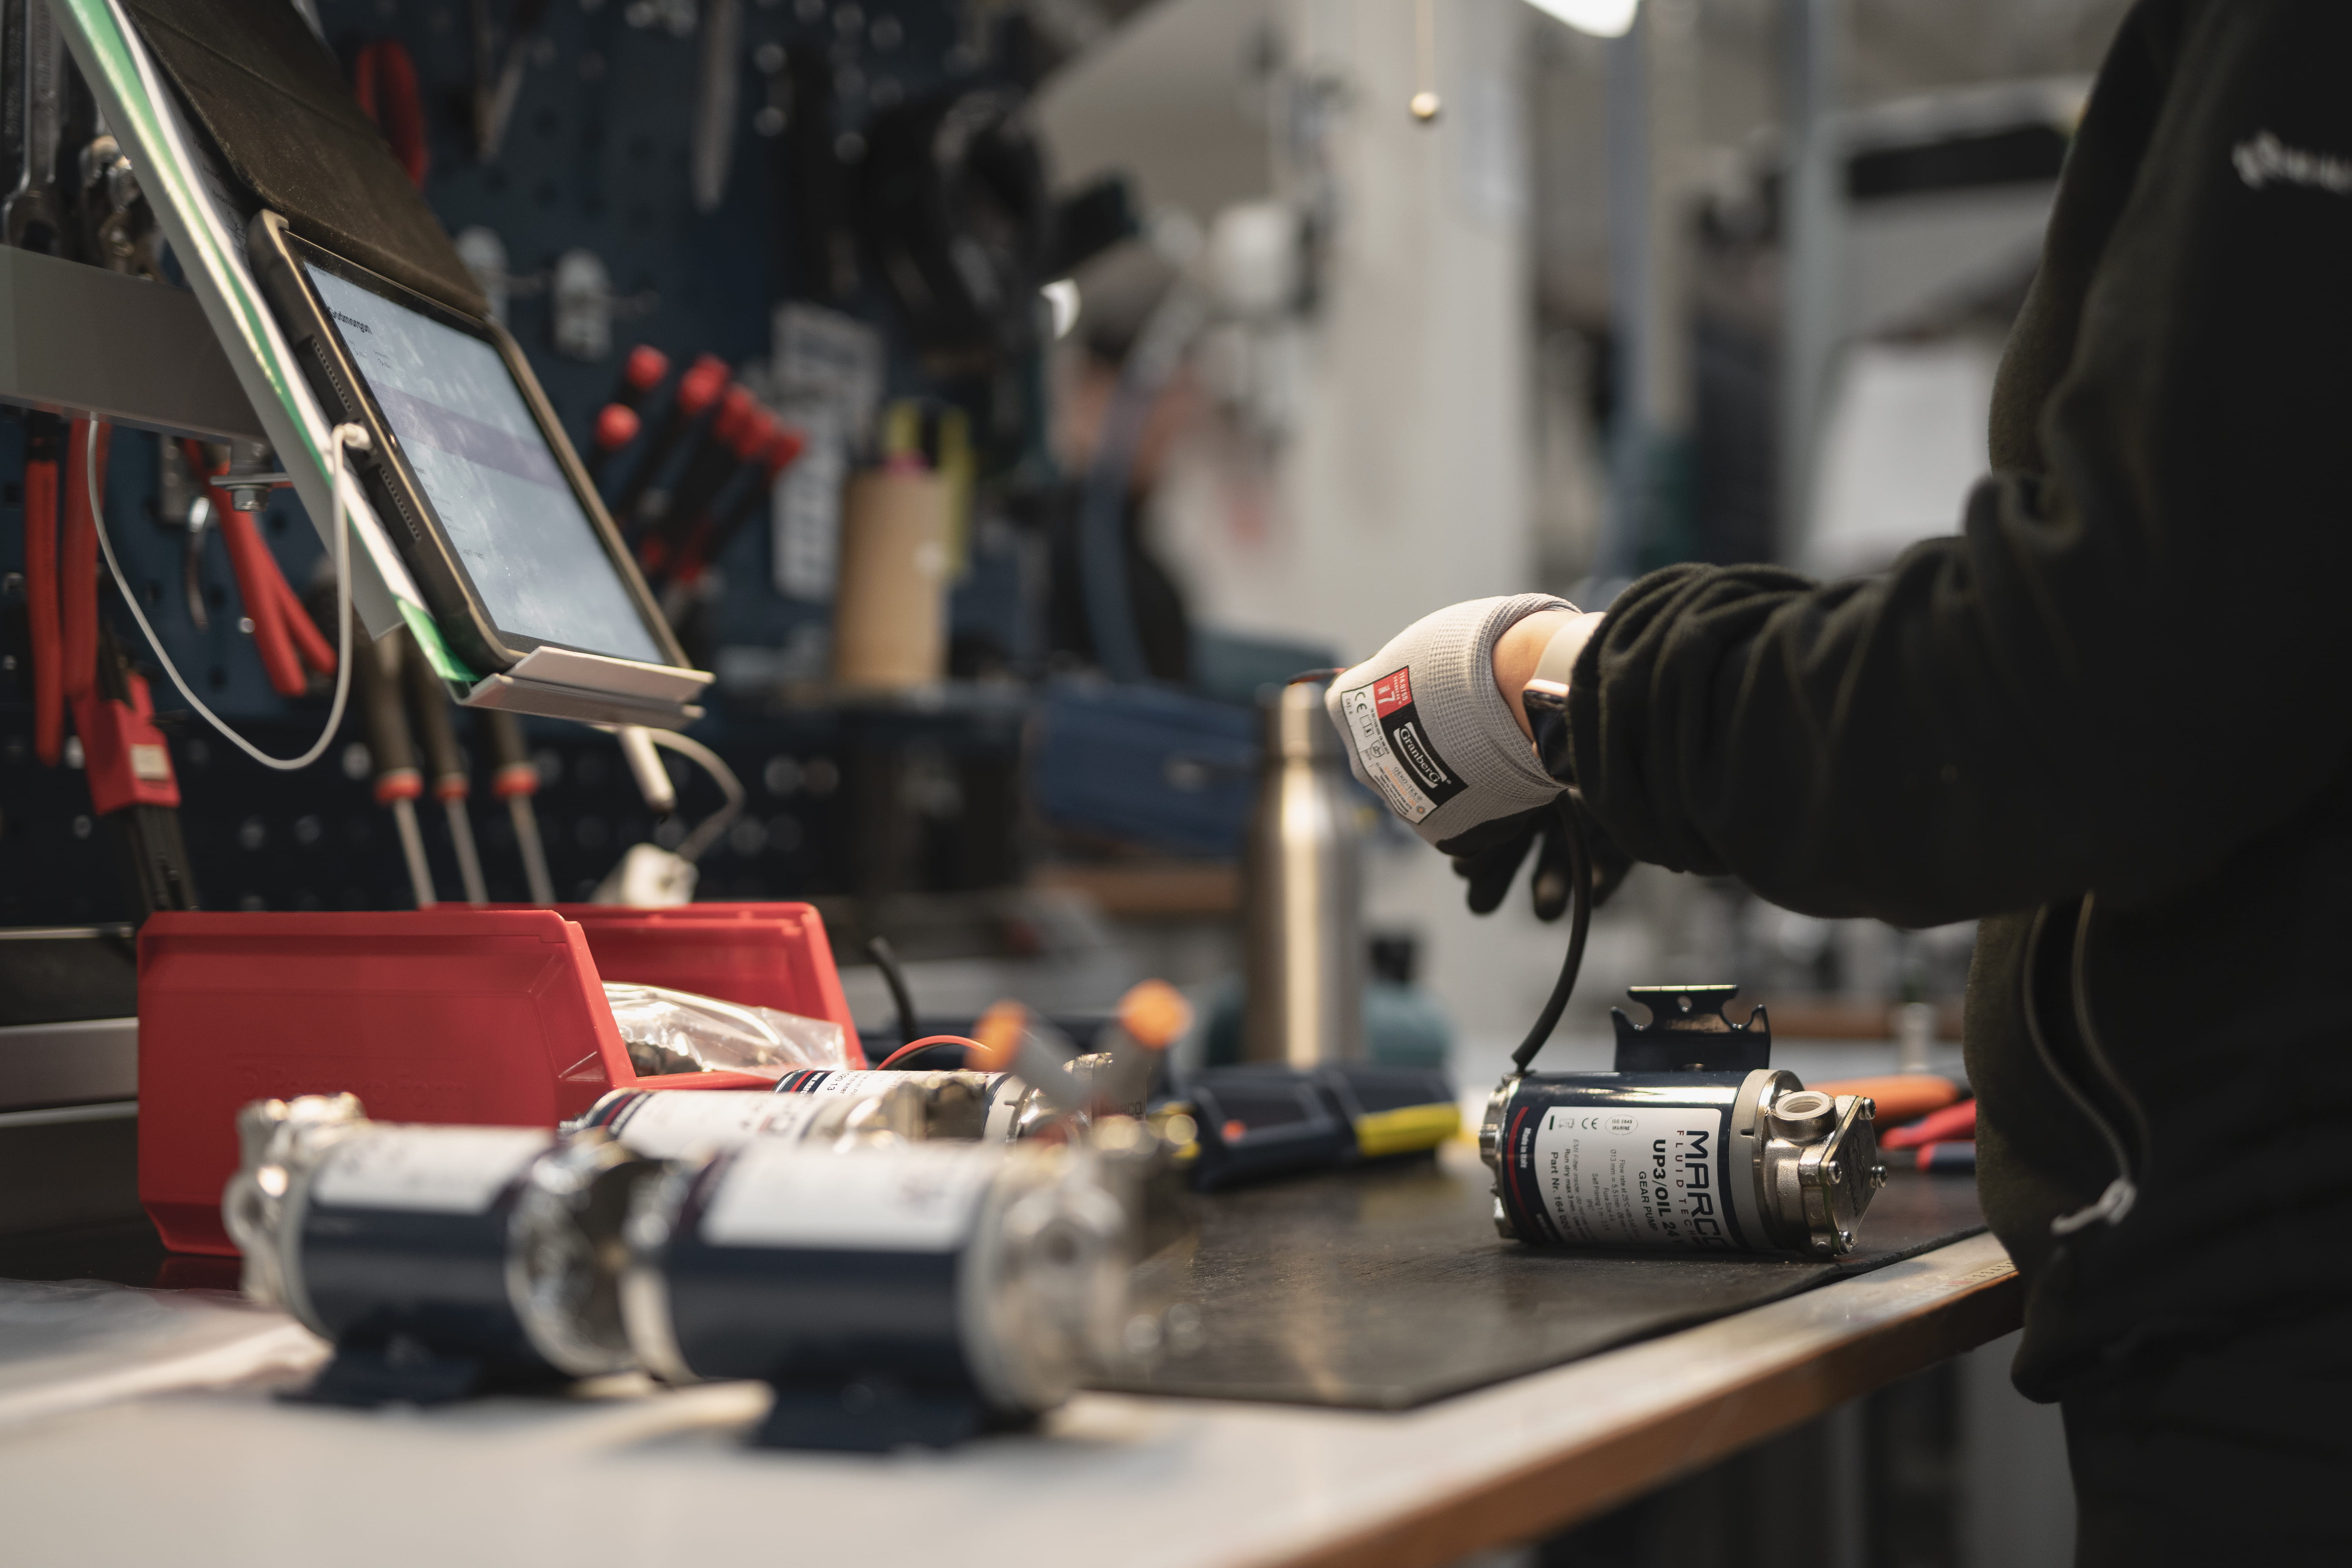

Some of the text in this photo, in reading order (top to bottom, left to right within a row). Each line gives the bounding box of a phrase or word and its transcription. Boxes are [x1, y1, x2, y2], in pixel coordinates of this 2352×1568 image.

[1378, 690, 1396, 704] 7
[1551, 1152, 1559, 1174] Part
[1610, 1163, 1615, 1175] mm
[1675, 1130, 1684, 1188] FLUID
[1552, 1177, 1560, 1193] Nr.
[1593, 1185, 1601, 1207] Priming
[1652, 1139, 1671, 1217] UP3/OIL
[1662, 1221, 1680, 1237] 24
[1554, 1195, 1564, 1212] 164
[1639, 1171, 1658, 1231] GEAR PUMP
[1679, 1198, 1697, 1236] TECH
